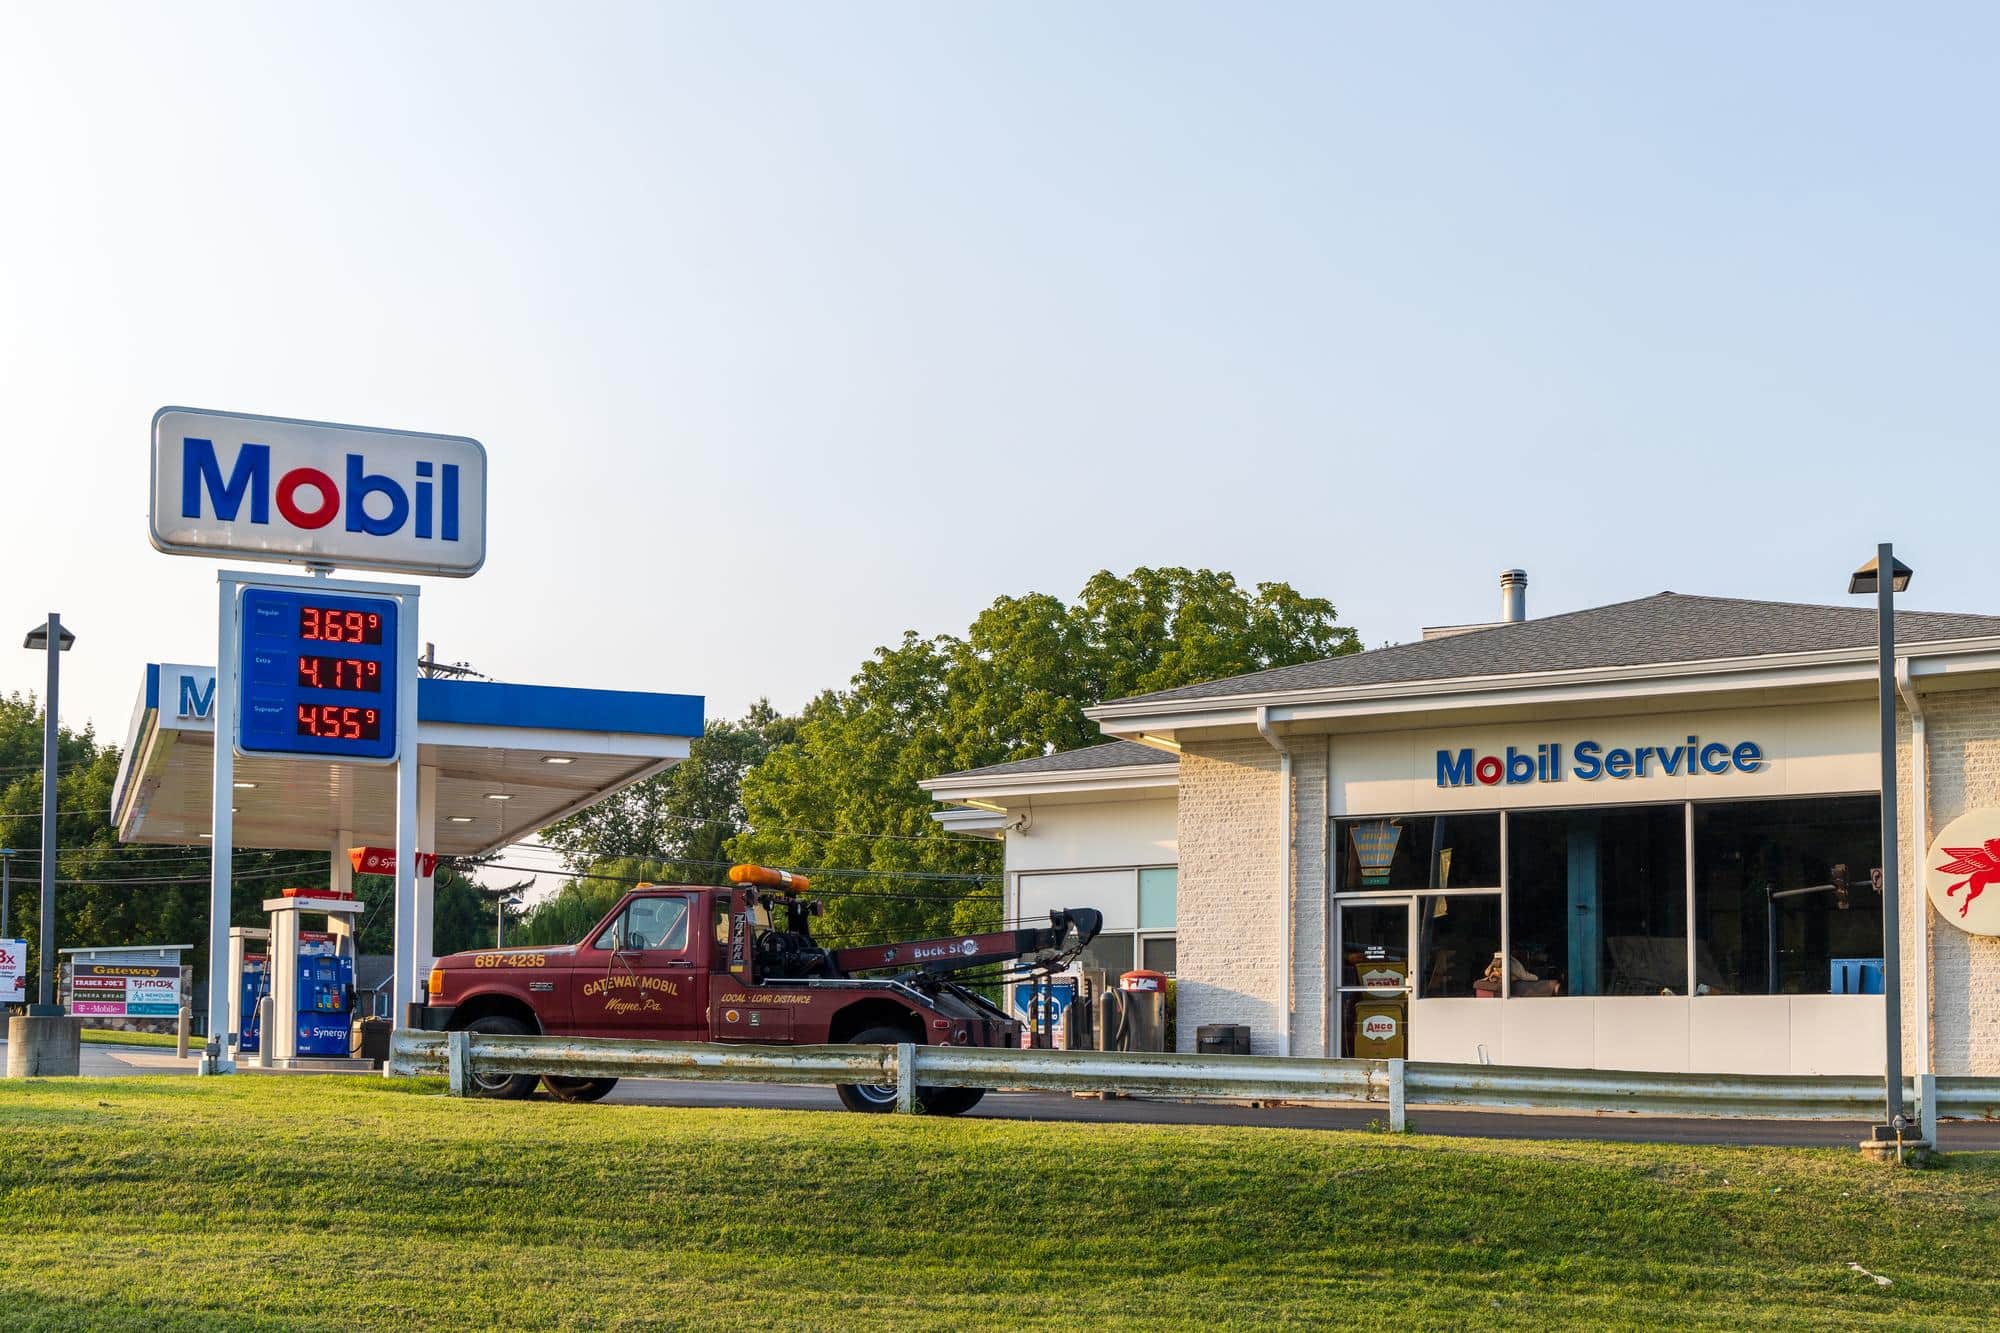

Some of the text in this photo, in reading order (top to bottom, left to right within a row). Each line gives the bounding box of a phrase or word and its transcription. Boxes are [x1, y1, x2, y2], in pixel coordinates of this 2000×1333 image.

[182, 437, 459, 541] Mobil
[1436, 735, 1762, 787] Mobil Service
[914, 946, 945, 958] Buck
[474, 953, 546, 968] 687-4235
[92, 966, 160, 976] Gateway
[583, 975, 679, 996] GATEWAY MOBIL
[721, 993, 812, 1004] LOCAL LONG DISTANCE
[313, 1027, 348, 1040] Synergy
